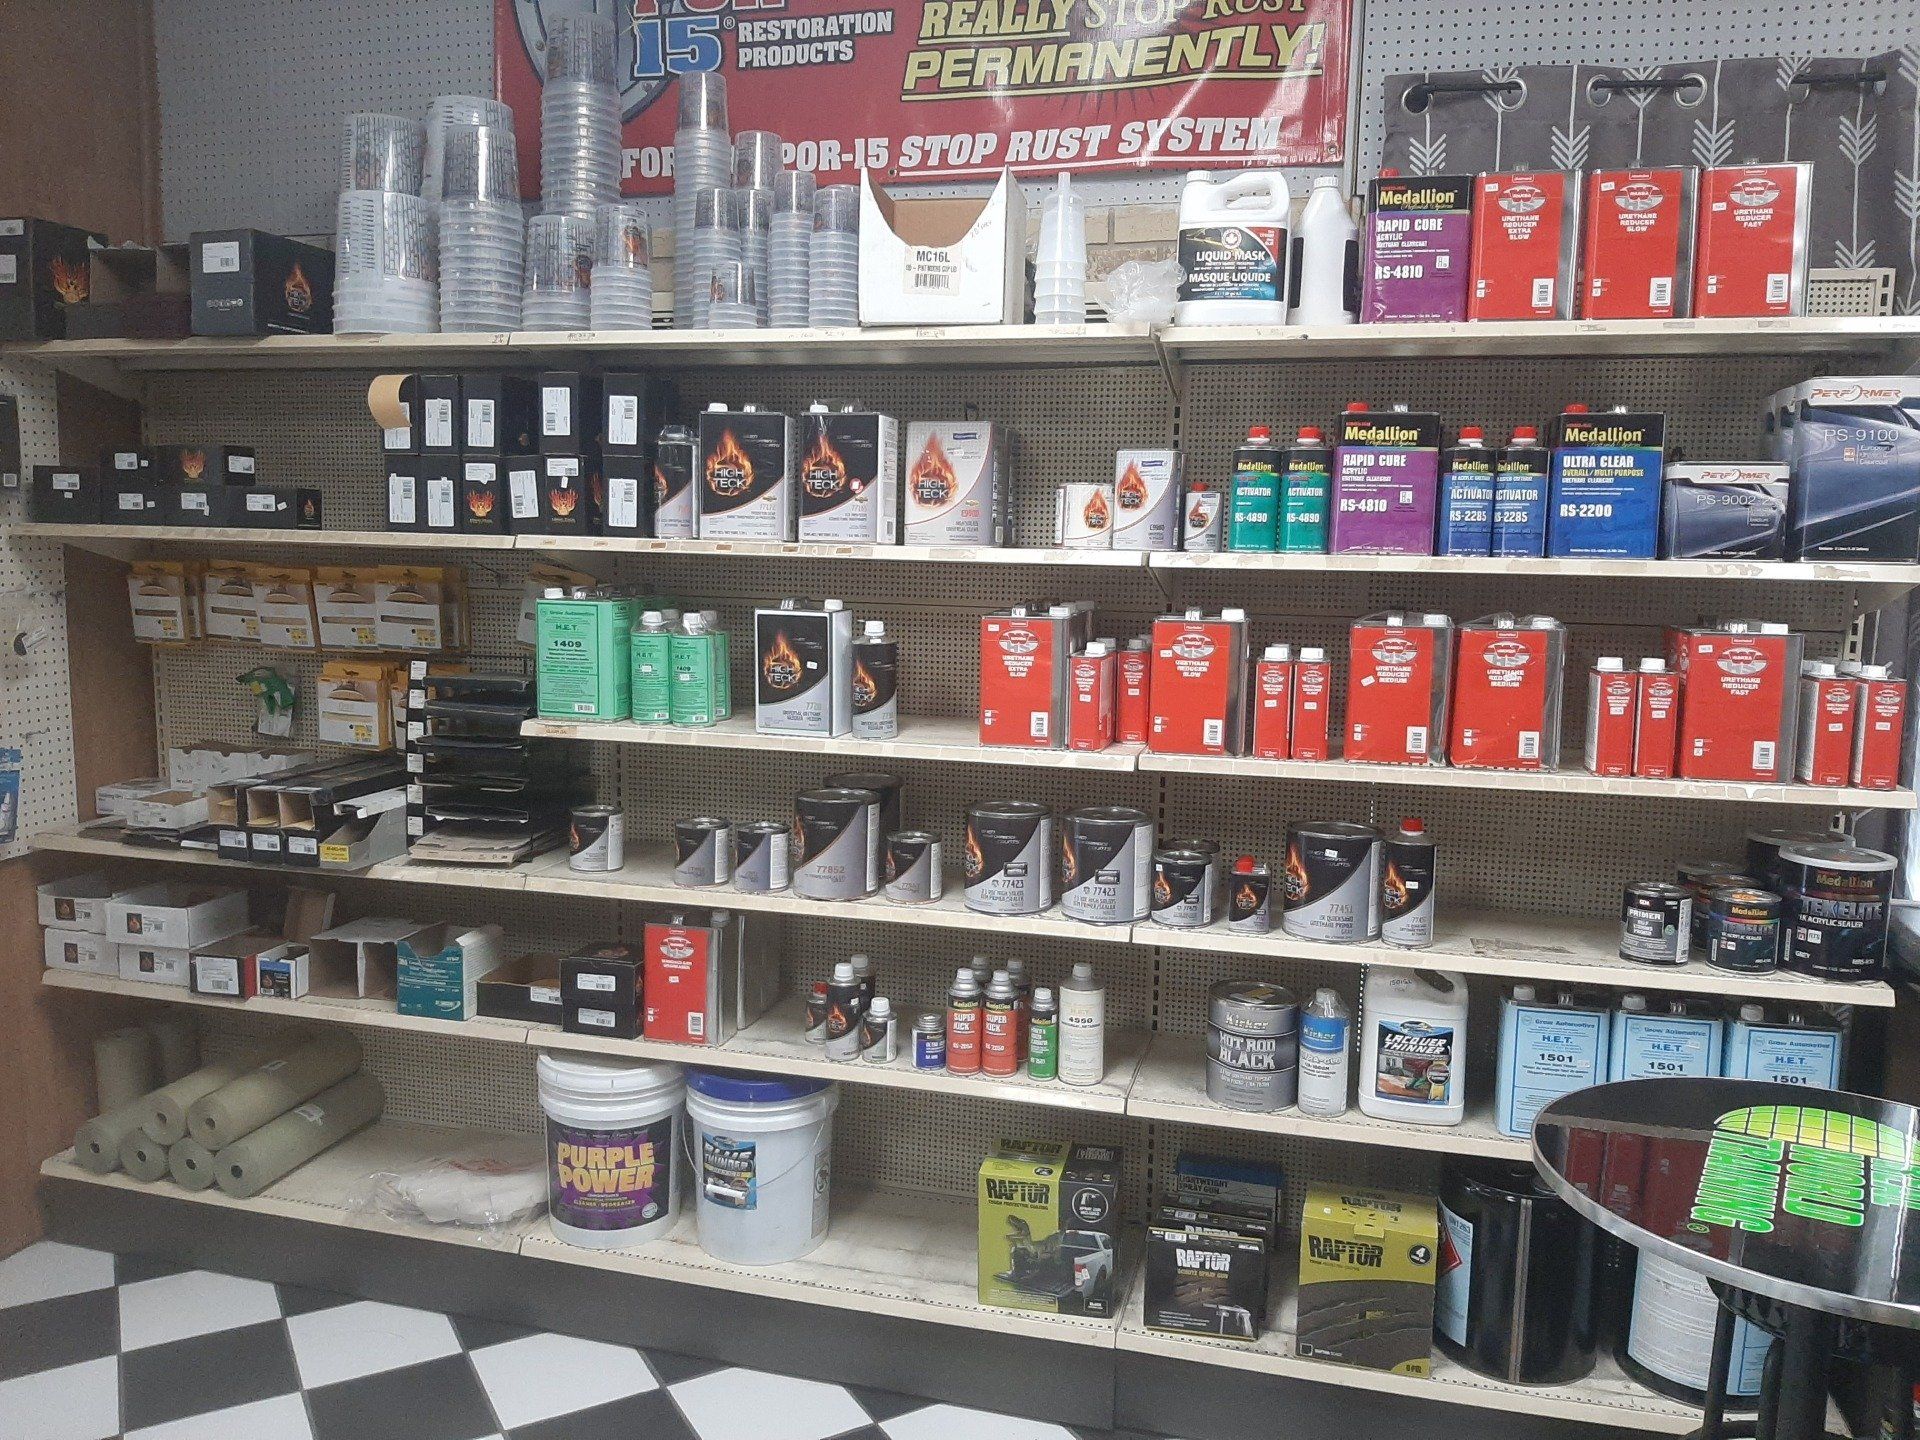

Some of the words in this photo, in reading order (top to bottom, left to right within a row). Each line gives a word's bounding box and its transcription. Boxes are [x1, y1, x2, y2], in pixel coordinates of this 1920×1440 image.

[919, 0, 1078, 38] REALLY
[1084, 0, 1190, 30] STOP
[737, 11, 894, 43] RESTORATION
[737, 40, 854, 68] PRODUCTS
[902, 22, 1328, 90] PERMANENTLY!
[900, 133, 997, 168] STOP
[1005, 125, 1111, 162] RUST
[1118, 115, 1284, 154] SYSTEM
[1379, 189, 1455, 206] Medallion
[1733, 208, 1774, 216] URETHANE
[1619, 219, 1655, 227] REDUCER
[1735, 214, 1772, 222] REDUCER
[1377, 219, 1410, 232] RAPID
[916, 251, 950, 263] MC16L
[1196, 250, 1232, 262] LIQUID
[1235, 250, 1266, 261] MASK
[1189, 272, 1229, 283] MASQUE
[1231, 272, 1271, 283] LIQUIDE
[1375, 265, 1423, 280] RS-4810
[1811, 384, 1902, 402] PERFORMER
[1344, 426, 1419, 441] Medallion
[1565, 427, 1643, 443] Medallion
[1824, 429, 1899, 442] PS-9100
[1237, 461, 1272, 471] Medallion
[1343, 454, 1375, 467] RAPID
[1378, 454, 1407, 467] CURE
[1563, 455, 1596, 468] ULTRA
[1600, 455, 1634, 468] CLEAR
[1288, 461, 1324, 472] Medallion
[1452, 461, 1489, 472] Medallion
[714, 468, 744, 478] HIGH
[810, 470, 838, 480] HIGH
[1700, 469, 1772, 483] PERFORMER
[713, 478, 746, 489] TECK
[808, 480, 840, 490] TECK
[917, 479, 947, 489] HIGH
[917, 488, 948, 499] TECK
[1236, 487, 1272, 497] ACTIVATOR
[1287, 487, 1323, 497] ACTIVATOR
[1340, 498, 1388, 513] RS-4810
[1560, 504, 1612, 518] RS-2200
[1449, 510, 1487, 522] RS-2285
[553, 640, 582, 648] 1409
[770, 666, 794, 675] HIGH
[769, 674, 796, 683] TECK
[1720, 676, 1761, 684] URETHANE
[816, 865, 846, 874] 77852
[1001, 879, 1024, 889] 77423
[1815, 872, 1875, 889] Medallion
[1093, 886, 1116, 896] 77423
[1628, 909, 1661, 920] PRIMER
[1731, 906, 1768, 917] Medallion
[1807, 915, 1836, 926] ACRYLIC
[1836, 919, 1864, 928] SEALER
[953, 1013, 976, 1022] SUPER
[985, 1014, 1007, 1023] SUPER
[1226, 1013, 1269, 1030] Kirker
[953, 1022, 970, 1031] KICK
[985, 1023, 1001, 1033] KICK
[1303, 1025, 1336, 1040] Kirker
[1219, 1031, 1245, 1051] HOT
[1246, 1038, 1276, 1052] ROD
[1384, 1033, 1447, 1047] LACQUER
[1542, 1034, 1573, 1044] H.E.T.
[1384, 1042, 1445, 1054] THINNER
[1651, 1043, 1683, 1052] H.E.T.
[1219, 1046, 1276, 1069] BLACK
[1539, 1053, 1574, 1063] 1501
[1774, 1056, 1808, 1065] H.E.T.
[1649, 1061, 1684, 1072] 1501
[1771, 1074, 1807, 1085] 1501
[557, 1141, 655, 1169] PURPLE
[558, 1163, 656, 1194] POWER
[1690, 1130, 1785, 1233] TRAINING
[1783, 1142, 1866, 1227] WORLD
[985, 1178, 1050, 1205] RAPTOR
[1308, 1234, 1384, 1268] RAPTOR
[1414, 1247, 1426, 1257] 4
[1176, 1248, 1231, 1271] RAPTOR
